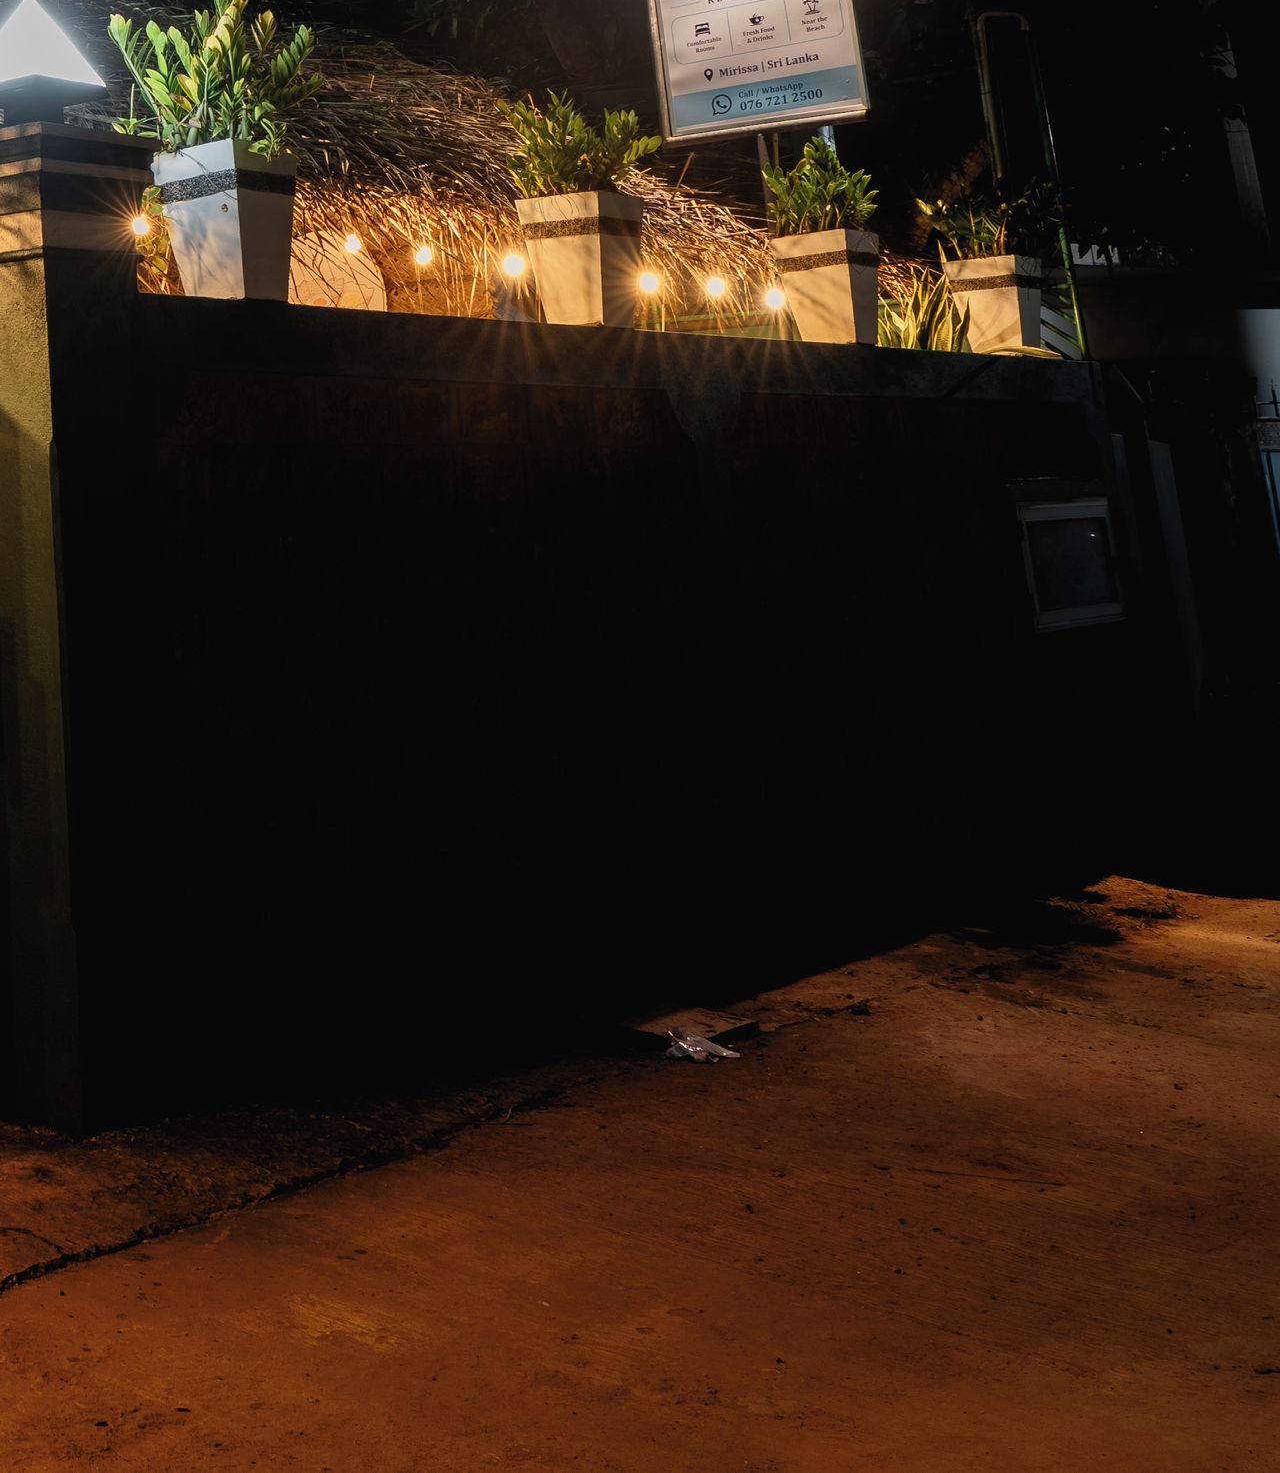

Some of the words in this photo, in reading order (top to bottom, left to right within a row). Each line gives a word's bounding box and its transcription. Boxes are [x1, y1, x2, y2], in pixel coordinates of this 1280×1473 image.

[801, 18, 816, 26] Near
[817, 15, 828, 23] the
[742, 28, 760, 37] Fresh
[760, 26, 775, 34] Food
[806, 24, 826, 32] Beach
[686, 36, 722, 48] Comfortable
[752, 34, 774, 43] Drinks
[695, 45, 715, 54] Rooms
[719, 63, 759, 78] Mirissa
[767, 56, 783, 70] Sri
[786, 52, 820, 66] Lanka
[738, 88, 754, 99] Call
[762, 81, 804, 95] WhatsApp
[740, 98, 763, 111] 076
[765, 93, 788, 107] 721
[792, 88, 823, 103] 2500
